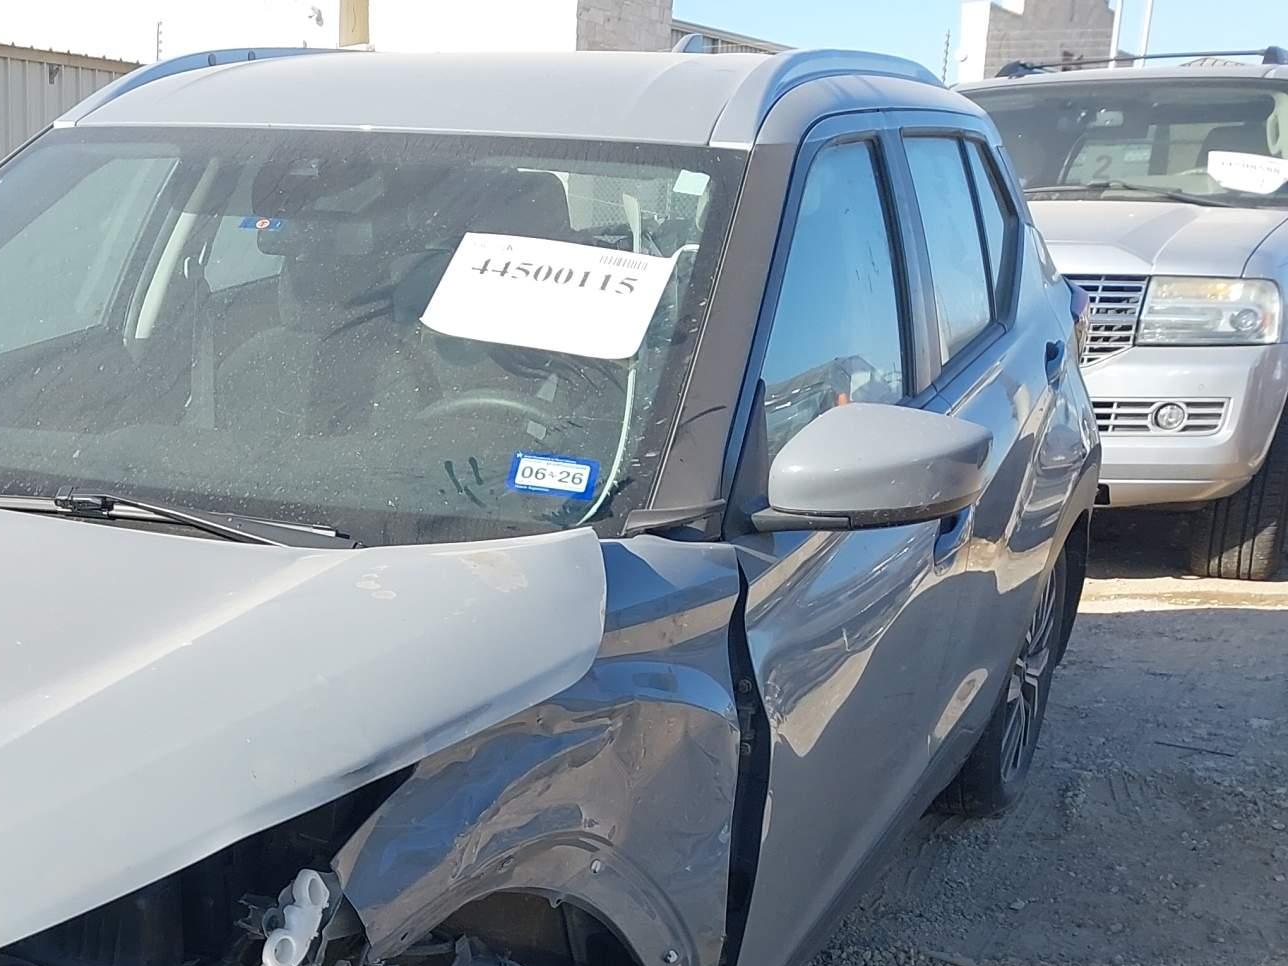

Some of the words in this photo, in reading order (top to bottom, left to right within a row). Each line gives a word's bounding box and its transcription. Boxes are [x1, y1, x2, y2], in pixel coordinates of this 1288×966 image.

[472, 258, 639, 294] 44500115
[521, 465, 547, 481] 06
[557, 470, 585, 486] 26
